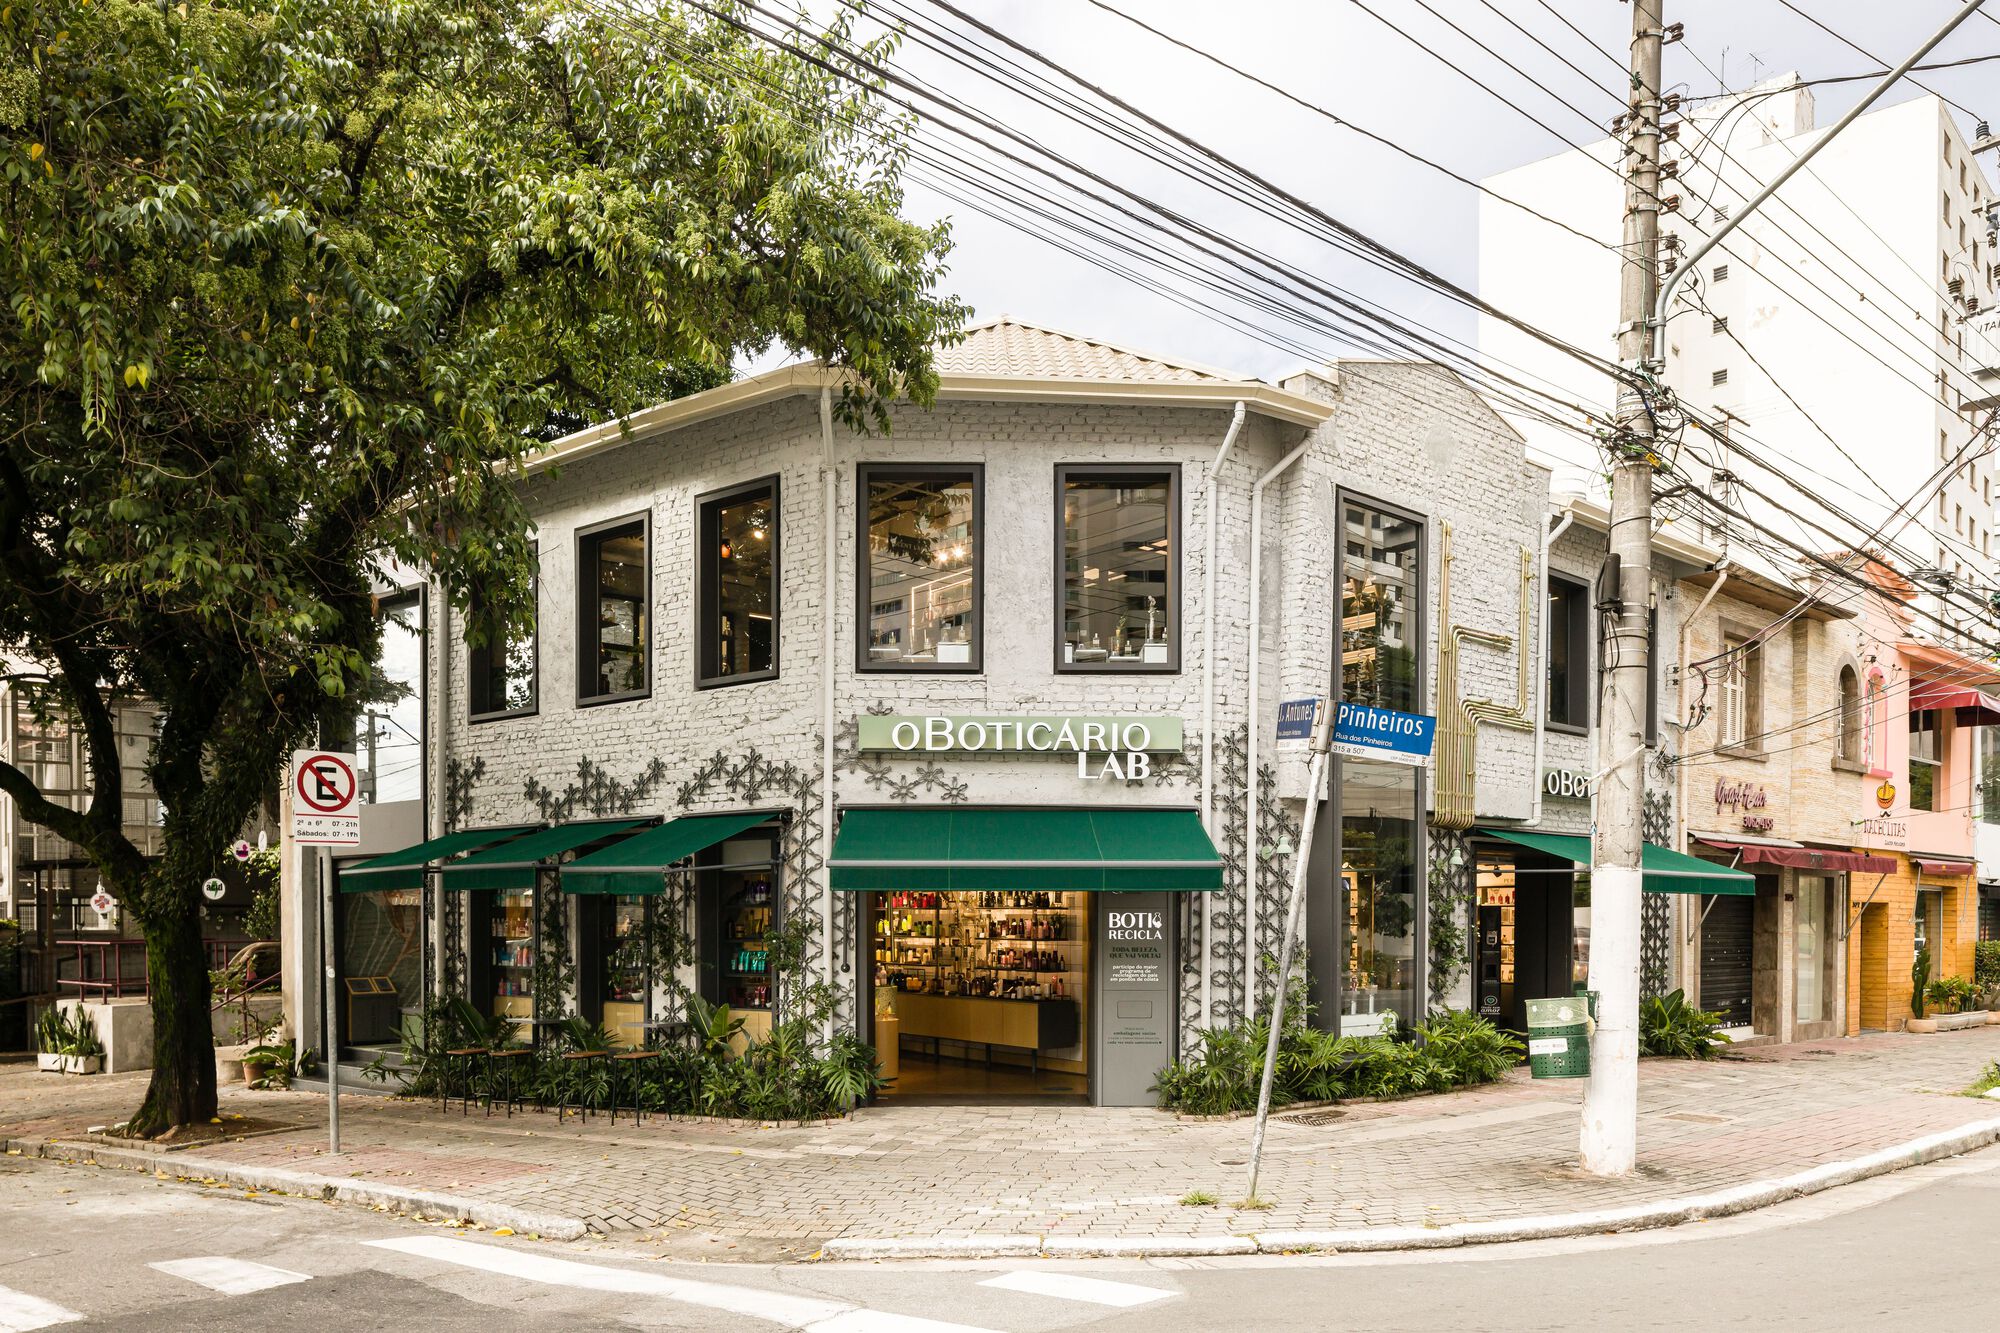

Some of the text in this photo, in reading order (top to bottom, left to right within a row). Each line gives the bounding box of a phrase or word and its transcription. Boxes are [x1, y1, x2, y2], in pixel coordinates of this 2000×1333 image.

[1285, 703, 1314, 722] Antunes
[1338, 705, 1424, 736] Pinheiros
[1335, 732, 1393, 747] Rua dos Pinheiros
[1333, 745, 1345, 753] 315
[1352, 747, 1365, 755] 507
[1078, 752, 1150, 780] LAB
[1108, 912, 1153, 929] BOTI
[1108, 929, 1163, 940] RECICLA
